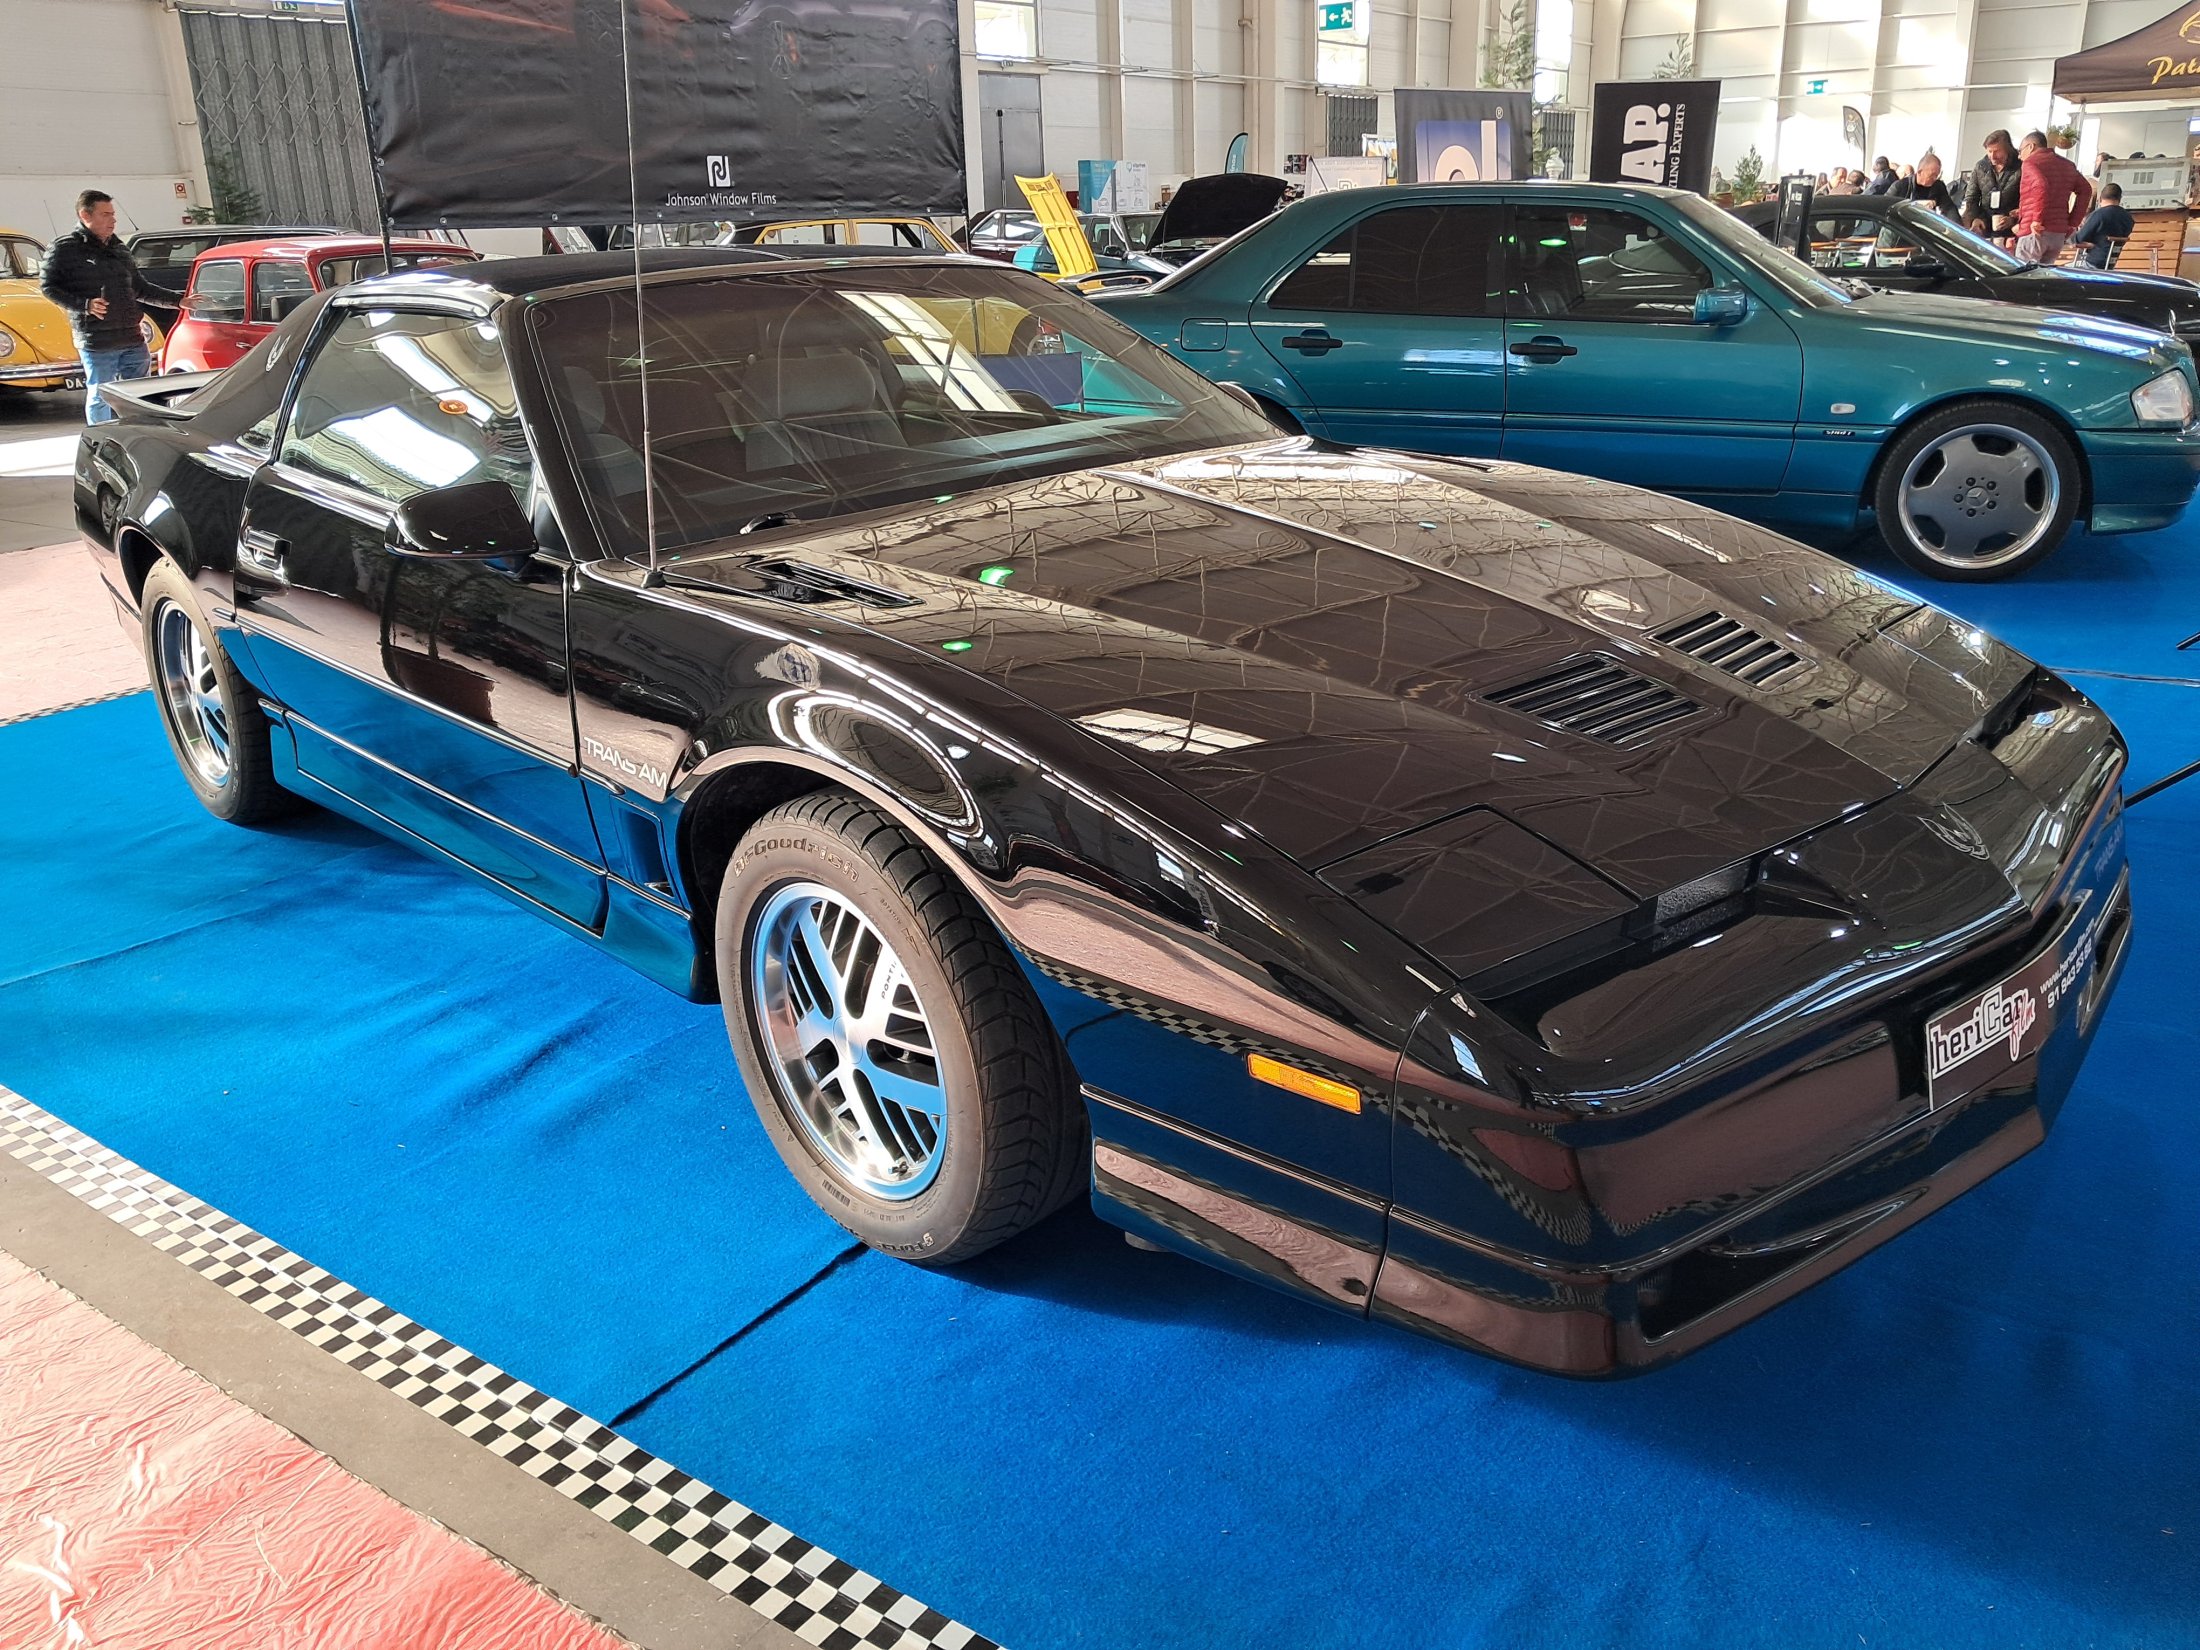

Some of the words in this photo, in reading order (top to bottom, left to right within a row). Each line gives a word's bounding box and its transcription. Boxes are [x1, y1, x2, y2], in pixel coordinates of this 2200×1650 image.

[1669, 103, 1686, 155] EXPERTS
[665, 193, 707, 206] Johnson
[710, 192, 748, 206] Window
[751, 192, 777, 205] Films
[583, 736, 637, 775] TRANS
[638, 763, 668, 791] AM
[733, 837, 860, 883] BFGoodrich
[2047, 985, 2061, 1009] 91
